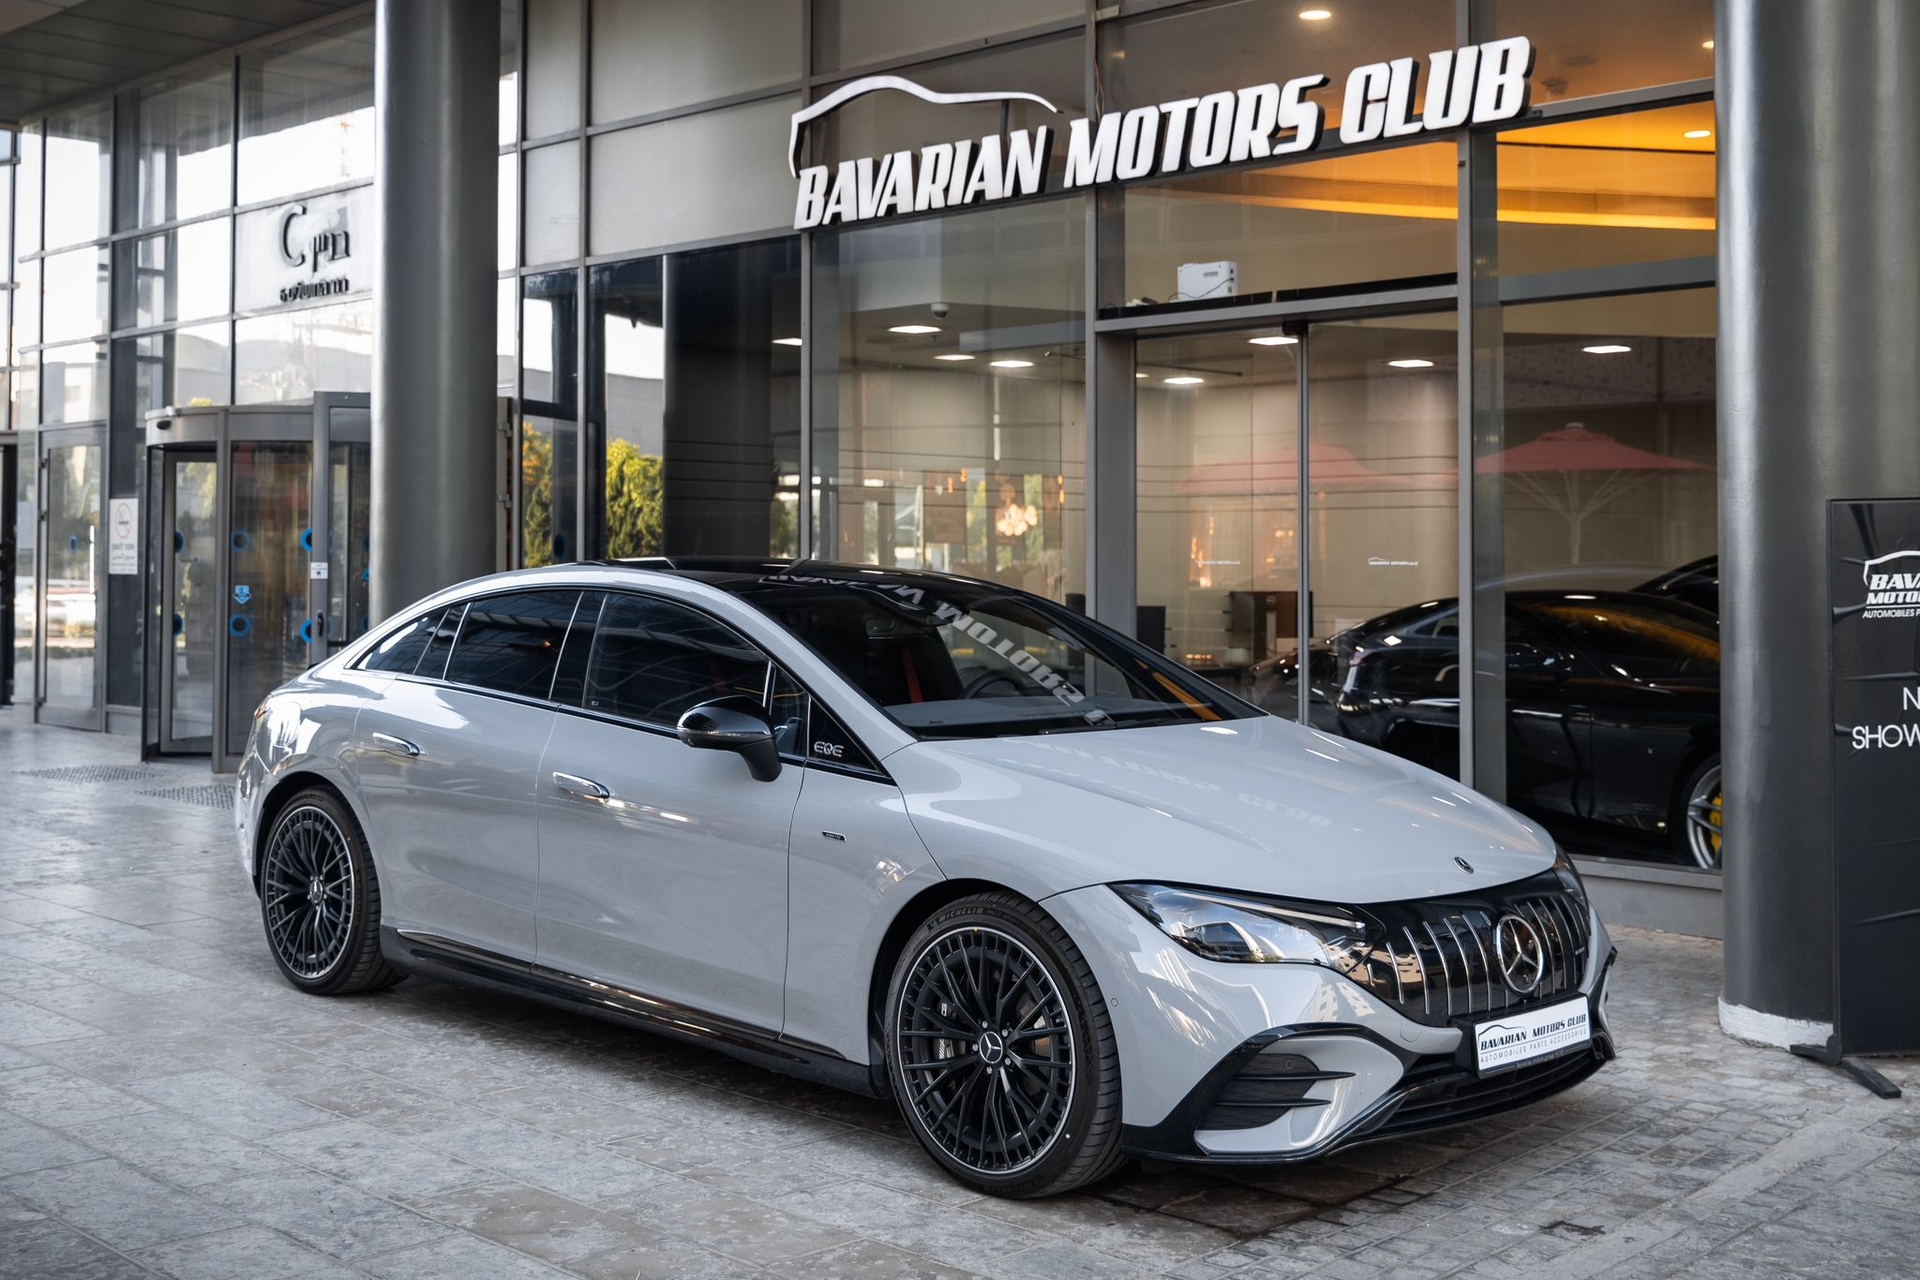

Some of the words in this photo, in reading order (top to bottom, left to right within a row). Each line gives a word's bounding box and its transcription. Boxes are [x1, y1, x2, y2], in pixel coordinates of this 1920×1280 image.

[793, 125, 1053, 230] BAVARIAN
[1063, 74, 1329, 189] MOTORS
[1339, 36, 1536, 143] CLUB
[1870, 573, 1920, 590] BAV
[1866, 591, 1920, 604] MOTO
[1862, 608, 1915, 618] AUTOMOBILES
[813, 741, 844, 757] EQE
[1481, 1032, 1526, 1050] BAVARIAN
[1533, 1021, 1565, 1037] MOTORS
[1567, 1014, 1586, 1026] CLUB
[1480, 1047, 1526, 1062] AUTOMOBILES
